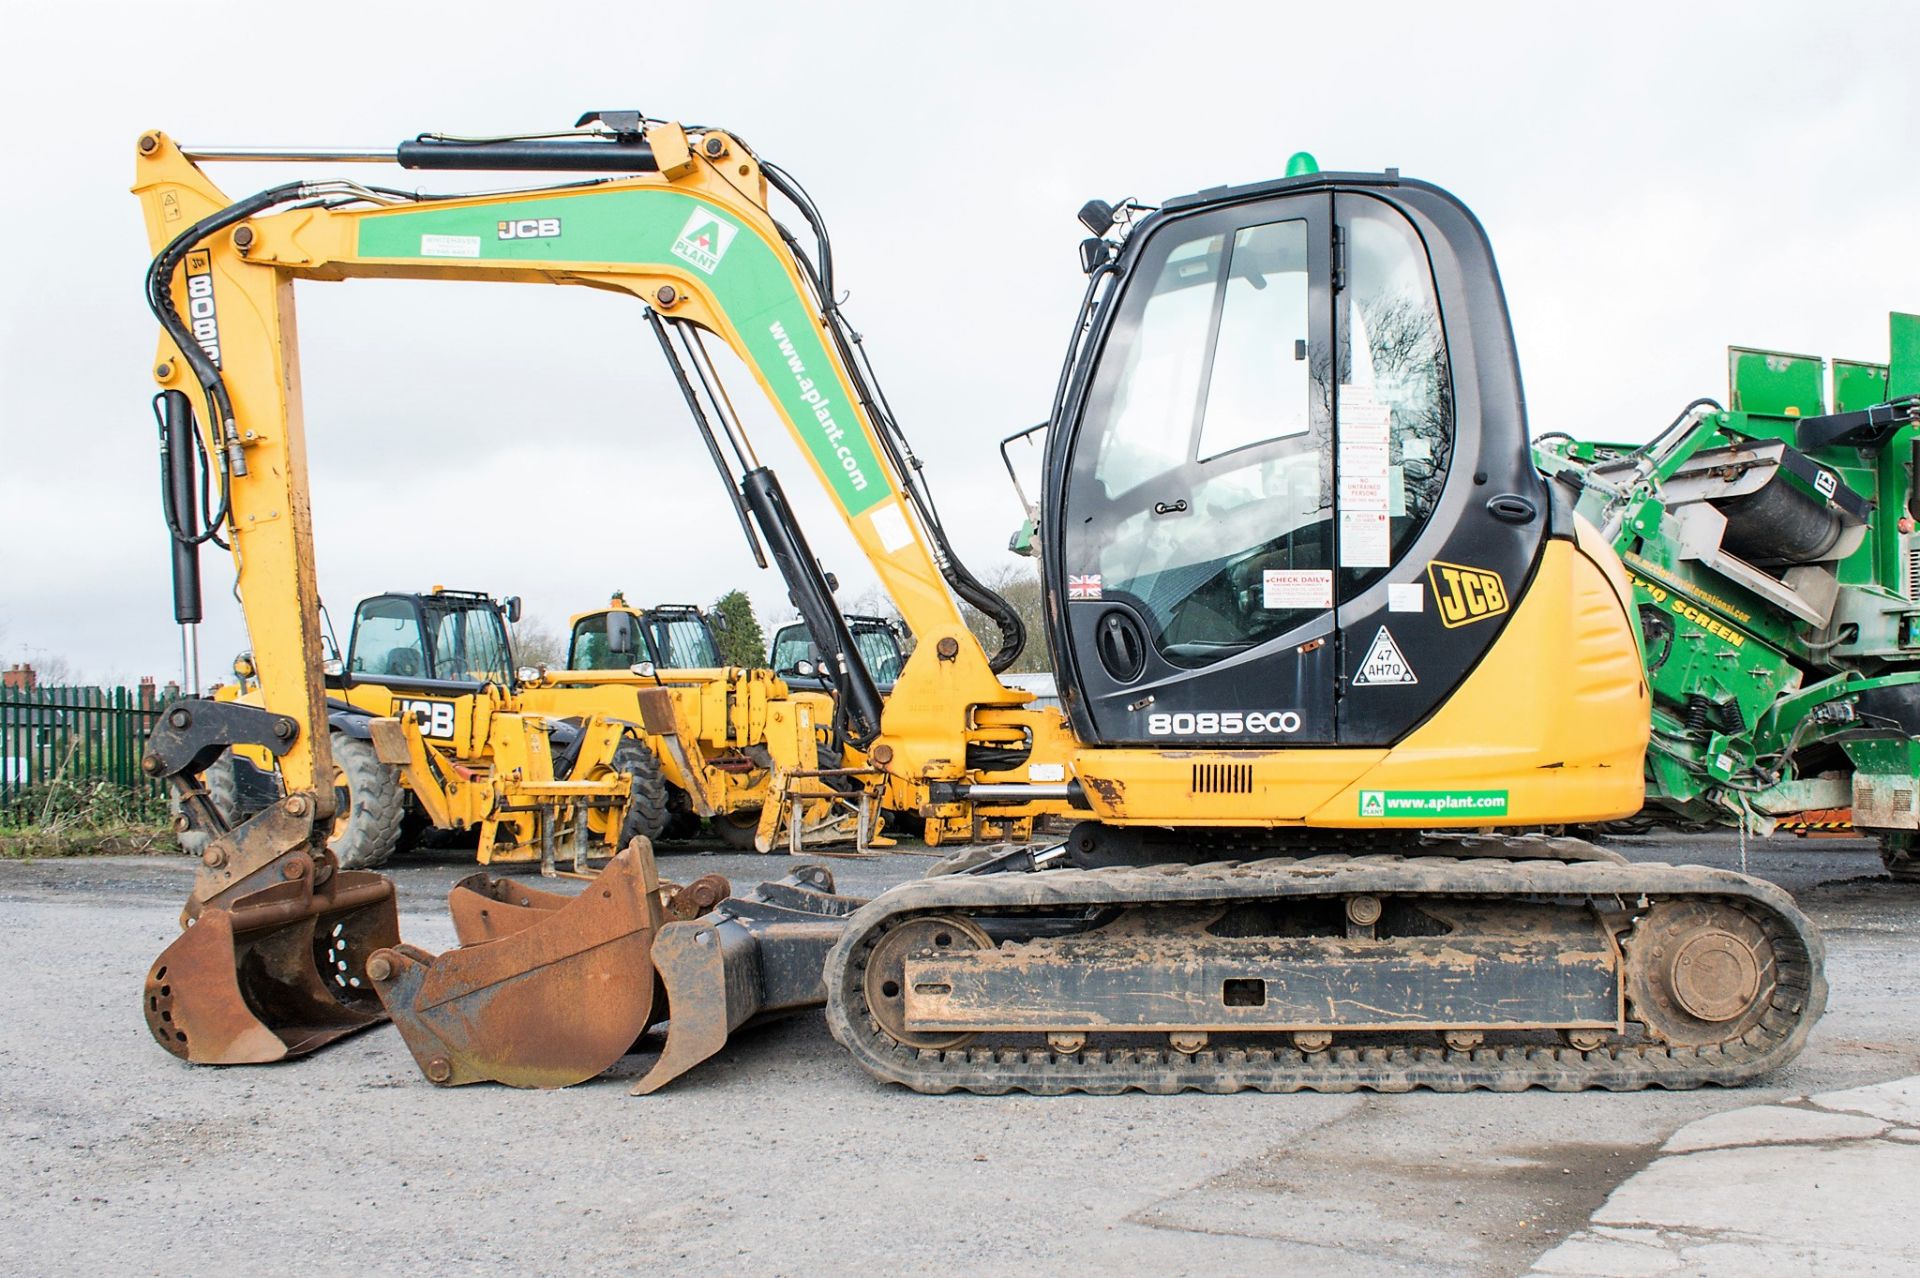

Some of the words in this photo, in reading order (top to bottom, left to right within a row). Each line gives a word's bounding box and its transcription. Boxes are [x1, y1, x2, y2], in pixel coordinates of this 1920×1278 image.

[498, 219, 561, 240] JCB
[686, 220, 719, 255] A
[674, 241, 717, 269] PLANT
[768, 320, 869, 492] www.aplant.com
[1441, 568, 1503, 621] JCB
[1671, 600, 1745, 647] SCREEN
[1377, 649, 1392, 661] 47
[1368, 664, 1401, 677] AH7Q
[1387, 796, 1505, 812] www.aplant.com
